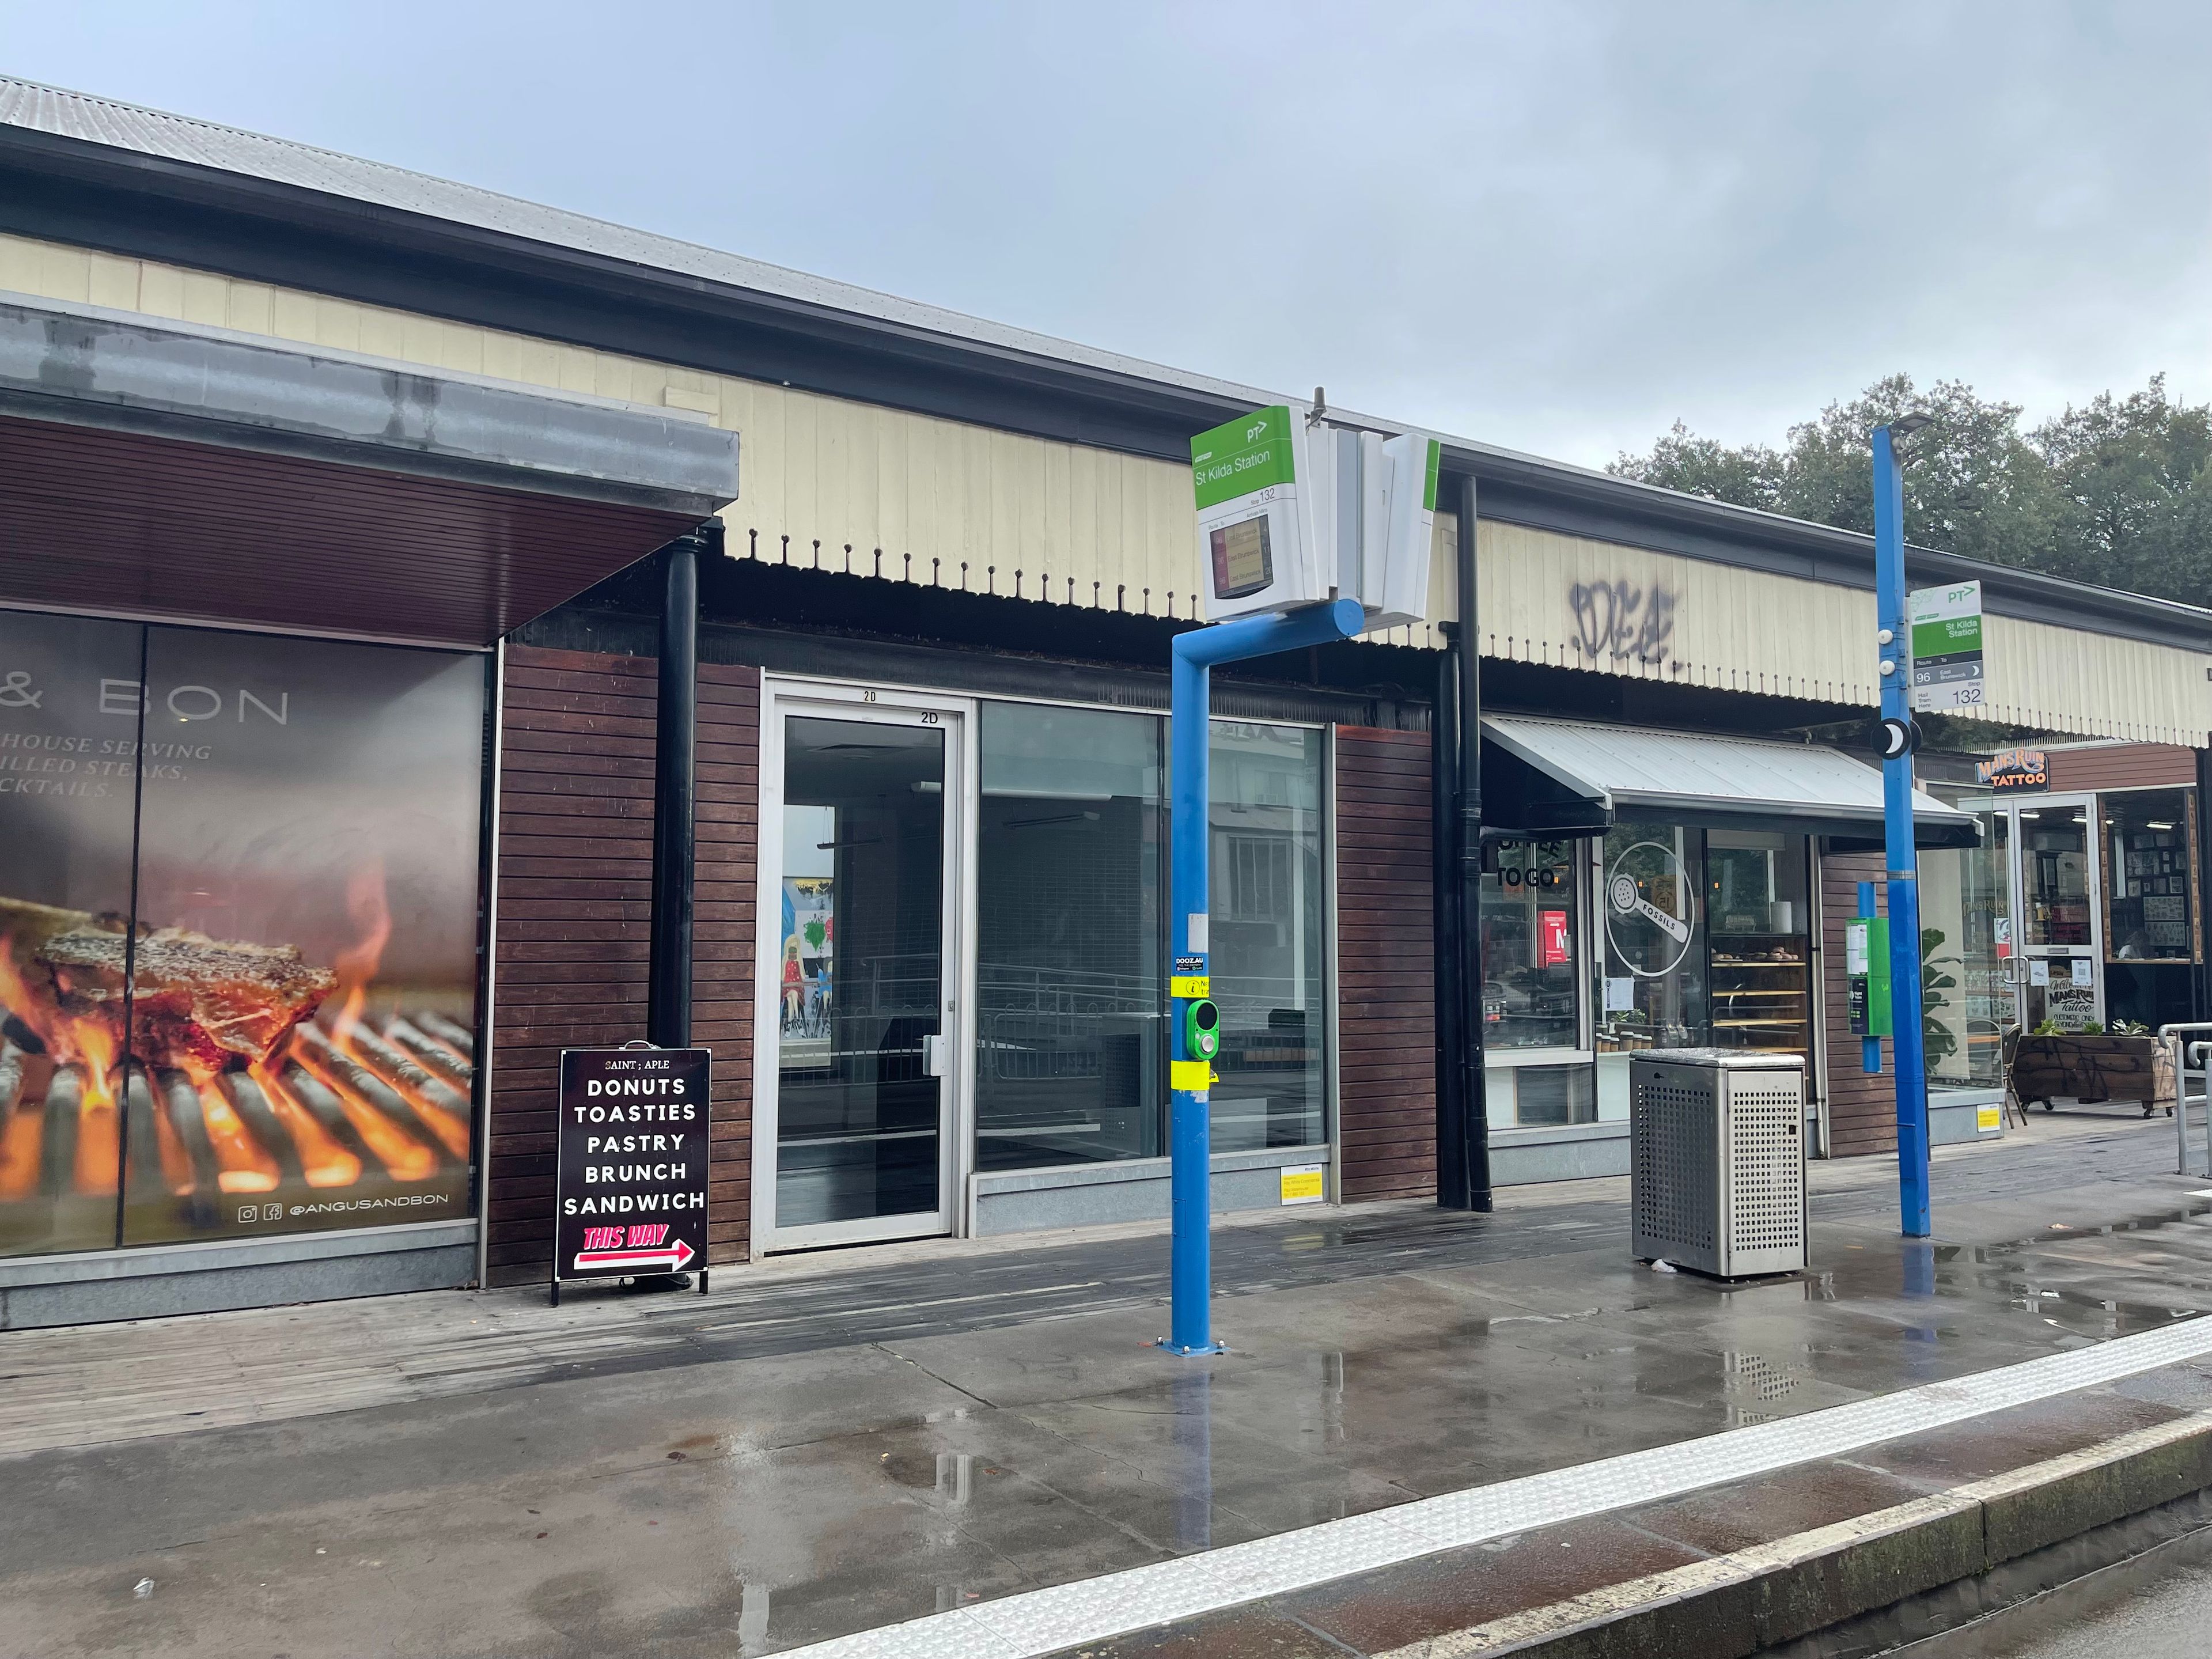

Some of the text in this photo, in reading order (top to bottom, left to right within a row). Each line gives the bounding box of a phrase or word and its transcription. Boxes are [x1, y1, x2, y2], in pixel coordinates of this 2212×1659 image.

[1196, 450, 1270, 486] St Kilda Station
[1260, 488, 1275, 502] 132
[1949, 628, 1978, 638] Station
[1957, 620, 1978, 629] Kilda
[1916, 672, 1931, 683] 96
[1940, 672, 1966, 680] Brunswick
[0, 671, 287, 725] & BON
[1953, 689, 1980, 704] 132
[922, 711, 938, 724] 2D
[1, 733, 213, 760] HOUSE SERVING
[0, 756, 77, 773] ILLED
[0, 778, 113, 798] CKTAILS.
[1991, 772, 2046, 786] TATTOO
[1498, 868, 1554, 887] TO GO
[1643, 904, 1676, 930] FOSSILS
[2061, 999, 2094, 1013] Tattoo
[605, 1060, 636, 1070] SAINT
[644, 1060, 670, 1069] APLE
[588, 1078, 685, 1096] DONUTS
[574, 1104, 696, 1123] TOASTIES
[588, 1134, 685, 1153] PASTRY
[585, 1162, 686, 1183] BRUNCH
[290, 1194, 449, 1216] @ANGUSANDBON
[564, 1192, 704, 1215] SANDWICH
[584, 1224, 669, 1250] THIS WAY
